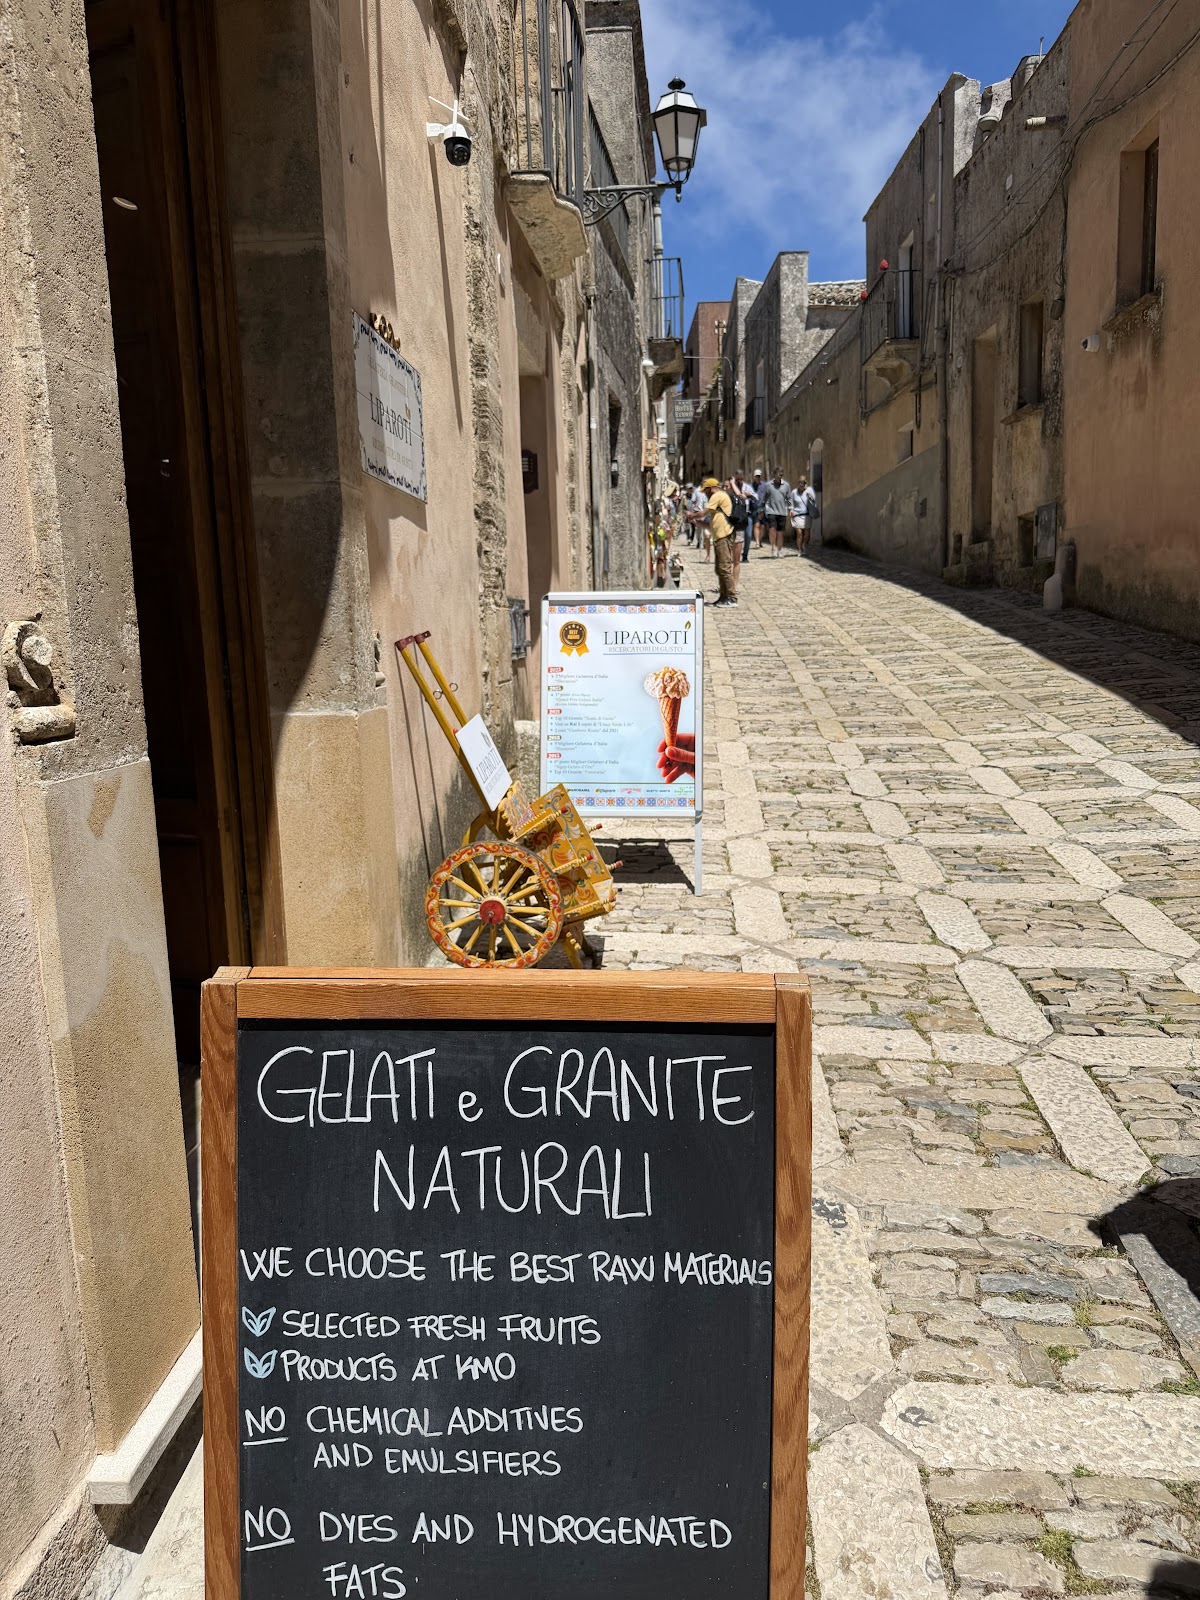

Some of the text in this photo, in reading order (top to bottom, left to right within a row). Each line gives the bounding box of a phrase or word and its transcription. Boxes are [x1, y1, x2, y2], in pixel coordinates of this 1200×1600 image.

[369, 393, 412, 446] LIPAROTI
[603, 630, 688, 645] LIPAROTI
[476, 747, 500, 784] LIPAROTI
[257, 1045, 755, 1127] GELATI e GRANITE
[373, 1141, 651, 1219] NATURALI
[239, 1246, 773, 1285] WE CHOOSE THE BEST RAW MATERIALS
[281, 1309, 602, 1345] SELECTED FRESH FRUITS
[280, 1348, 398, 1382] PRODUCTS
[410, 1353, 446, 1382] AT
[244, 1404, 584, 1438] NO CHEMICAL ADDITIVES
[313, 1441, 562, 1478] AND EMULSIFIERS
[244, 1504, 733, 1549] NO DYES AND HYDROGENATED
[322, 1561, 407, 1600] FATS
